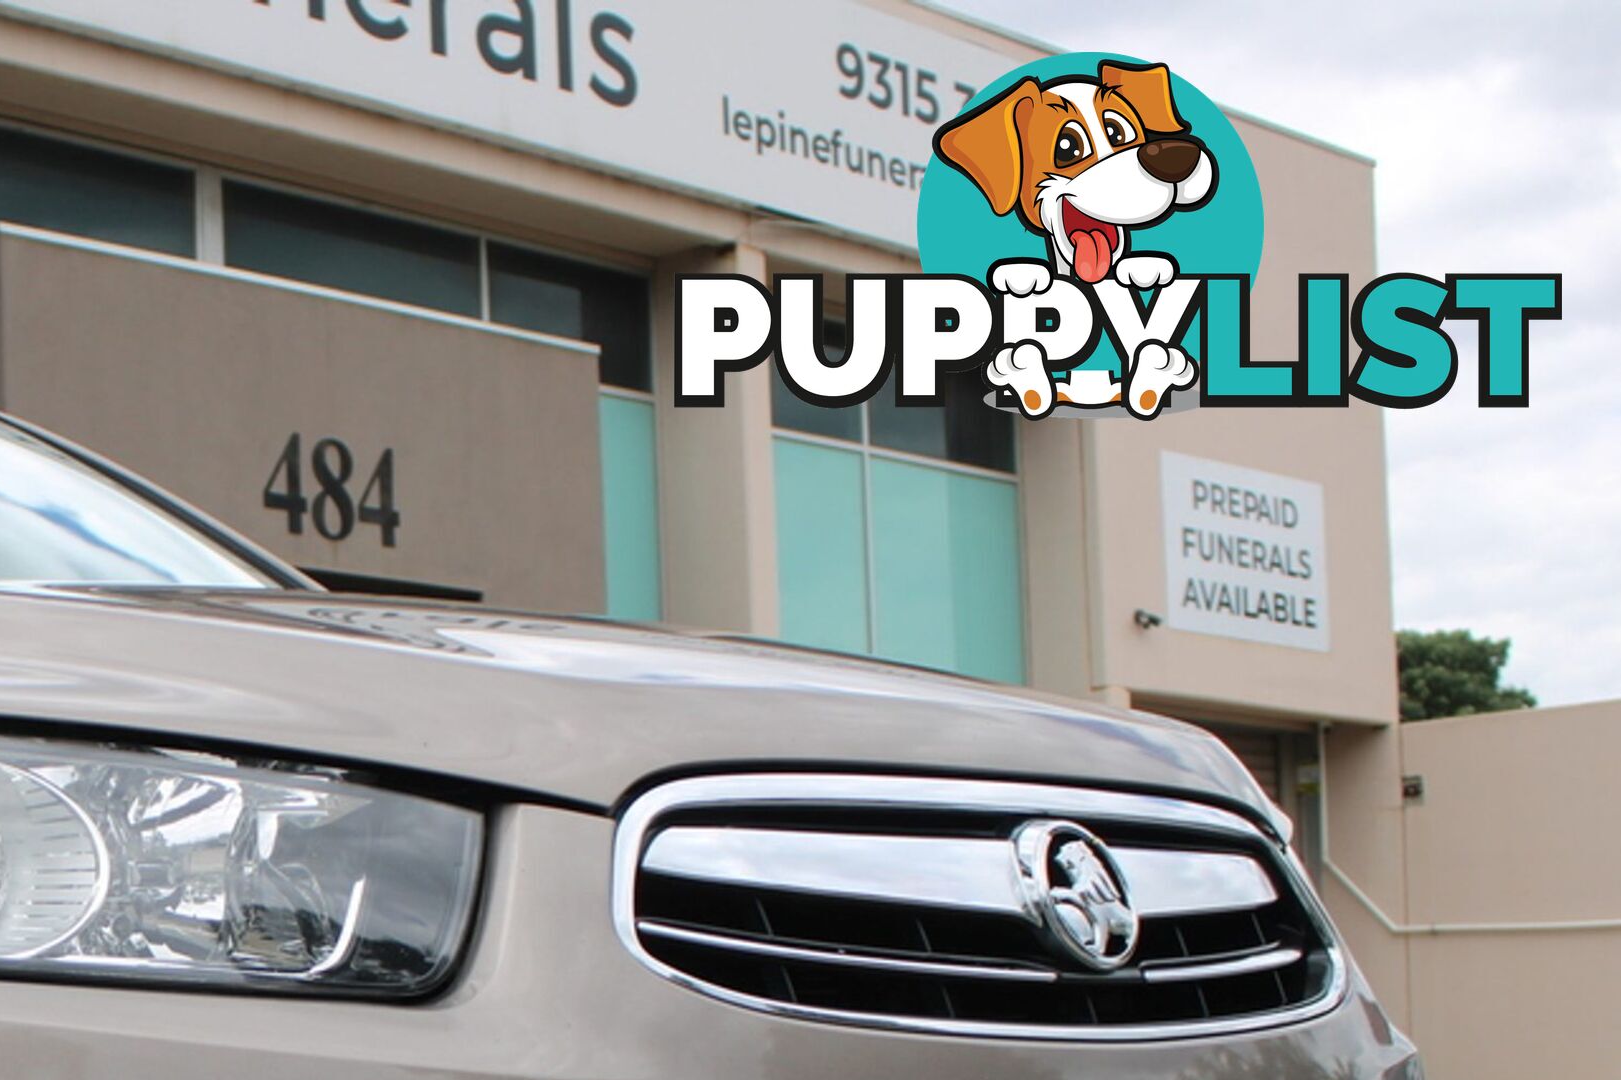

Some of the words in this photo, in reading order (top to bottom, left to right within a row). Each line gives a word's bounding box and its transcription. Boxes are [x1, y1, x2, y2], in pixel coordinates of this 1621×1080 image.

[836, 43, 941, 125] 9315
[722, 95, 926, 190] lepinefuner
[263, 432, 400, 548] 484
[1192, 479, 1298, 529] PREPAID
[1182, 526, 1312, 580] FUNERALS
[1183, 577, 1318, 629] AVAILABLE
